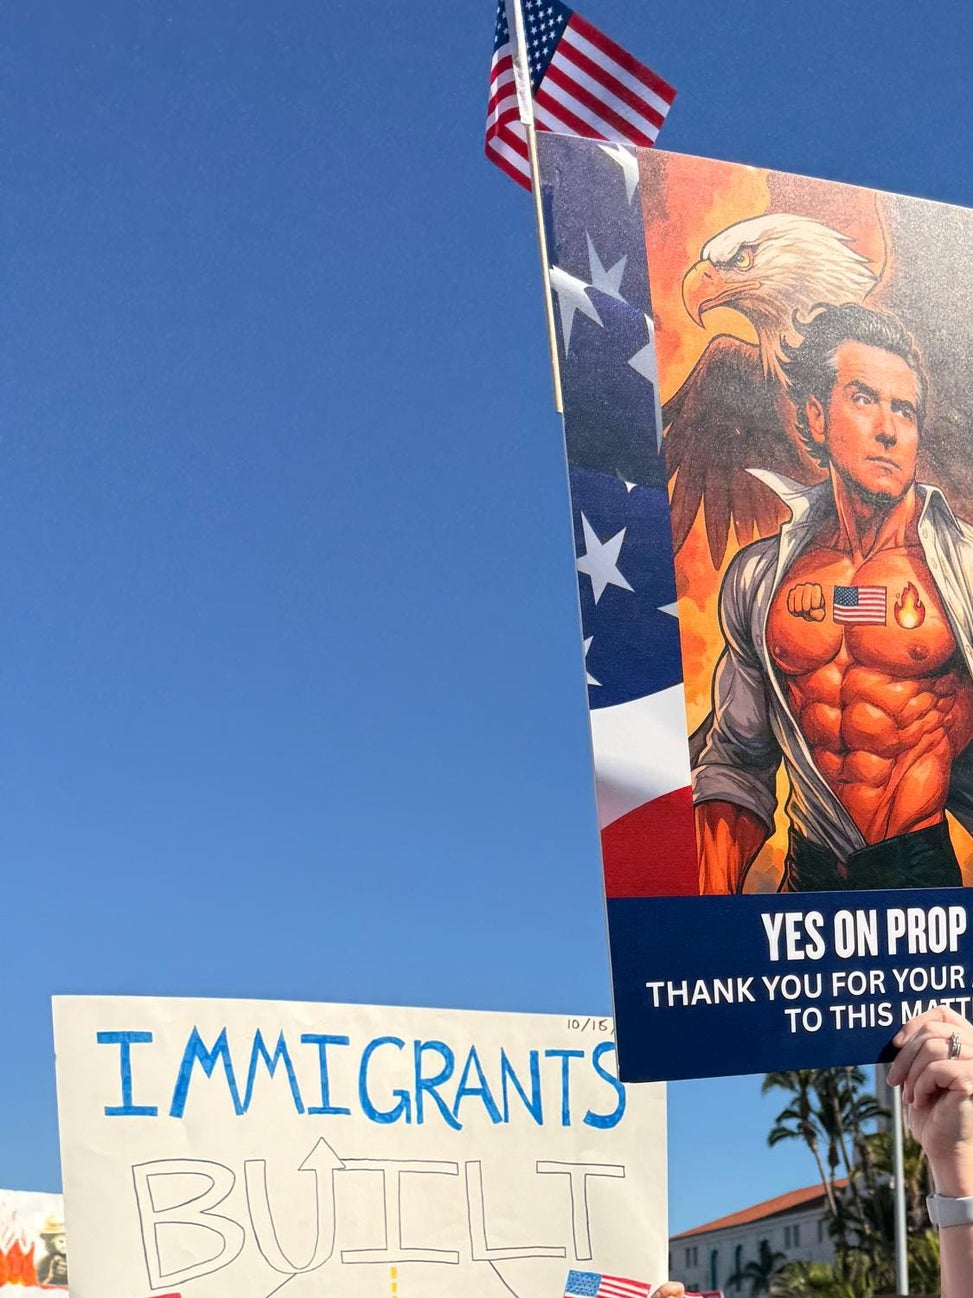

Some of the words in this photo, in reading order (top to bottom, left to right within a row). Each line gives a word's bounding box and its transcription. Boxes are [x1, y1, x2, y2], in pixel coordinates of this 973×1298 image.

[761, 911, 825, 961] YES
[834, 909, 879, 959] ON
[887, 906, 967, 955] PROP
[646, 978, 756, 1007] THANK
[761, 973, 824, 1001] YOU
[832, 969, 886, 996] FOR
[892, 966, 967, 992] YOUR
[784, 1007, 823, 1033] TO
[829, 1002, 893, 1030] THIS
[97, 1025, 627, 1130] IMMIGRANTS
[132, 1156, 626, 1290] BUILT
